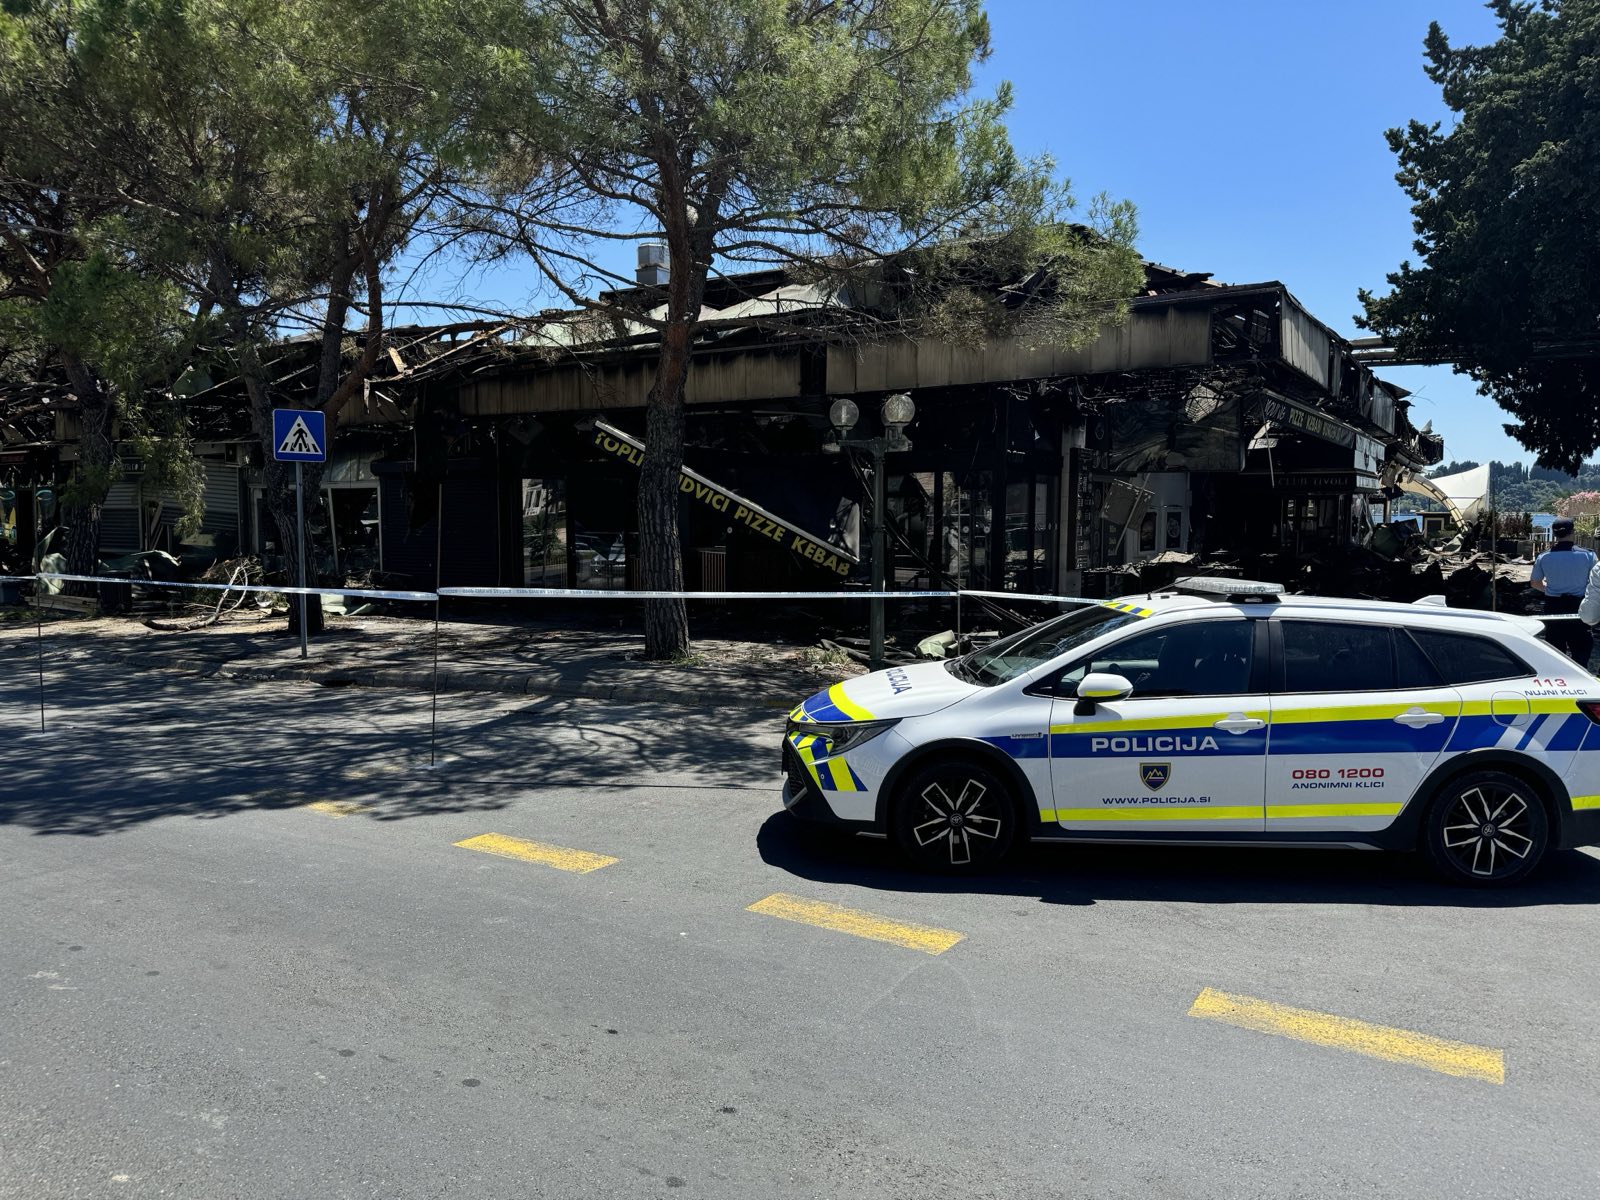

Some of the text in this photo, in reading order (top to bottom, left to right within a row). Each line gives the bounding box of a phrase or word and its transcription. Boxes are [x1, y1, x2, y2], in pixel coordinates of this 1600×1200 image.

[594, 431, 850, 576] TOPLI DVICI PIZZE KEBAB
[1533, 678, 1567, 687] 113
[1091, 736, 1220, 752] POLICIJA
[1291, 768, 1385, 780] 080 1200
[1291, 781, 1353, 789] ANONIMNI
[1102, 796, 1211, 805] WWW.POLICIJA.SI
